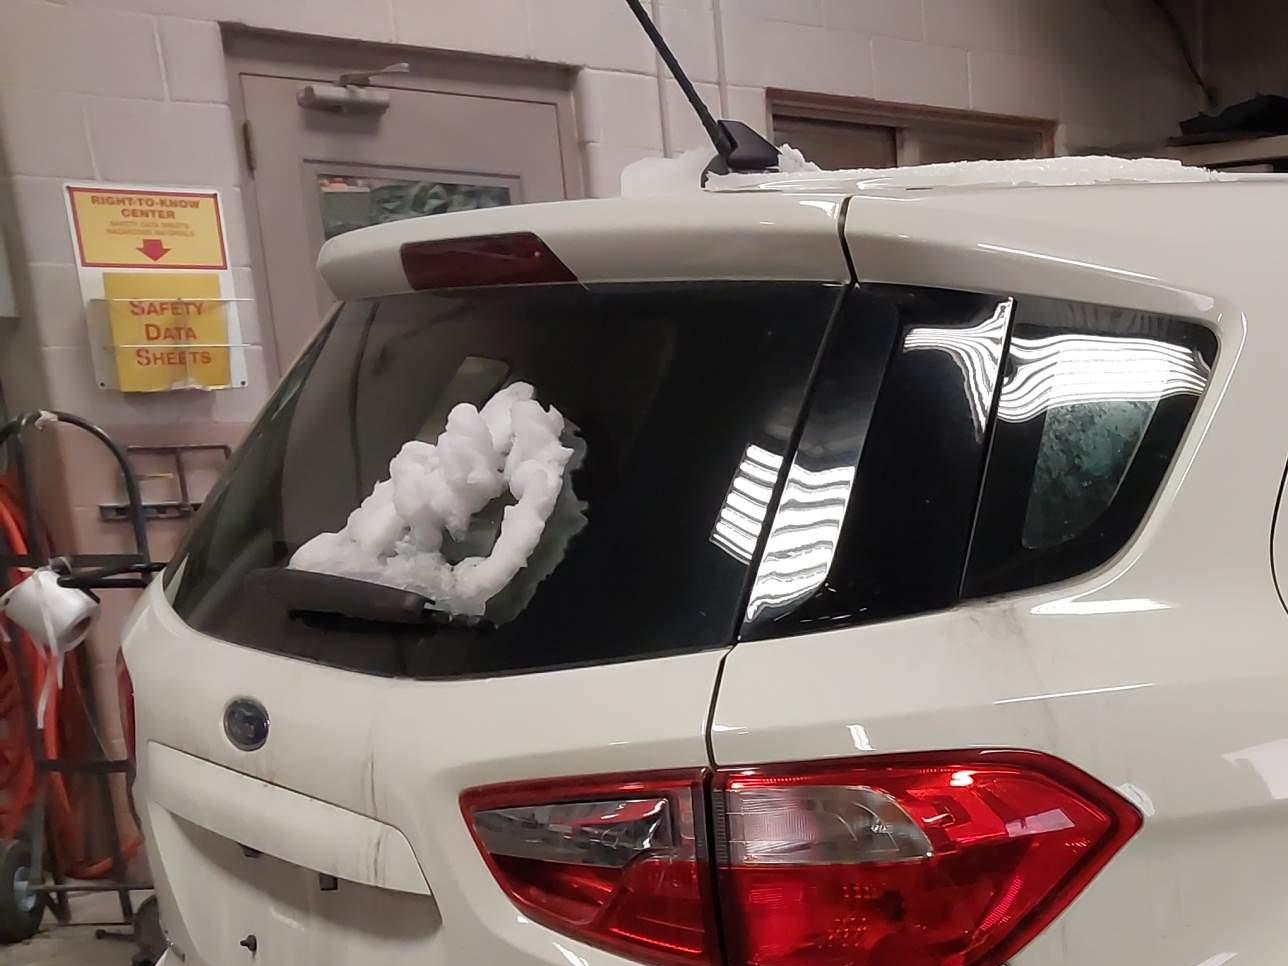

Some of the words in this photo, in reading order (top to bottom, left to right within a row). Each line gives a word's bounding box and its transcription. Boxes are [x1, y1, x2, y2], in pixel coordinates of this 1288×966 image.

[90, 195, 200, 209] RIGHT-TO-KNOW
[121, 208, 176, 219] CENTER
[129, 299, 204, 316] SAFETY
[144, 323, 198, 341] DATA
[135, 348, 212, 366] SHEETS
